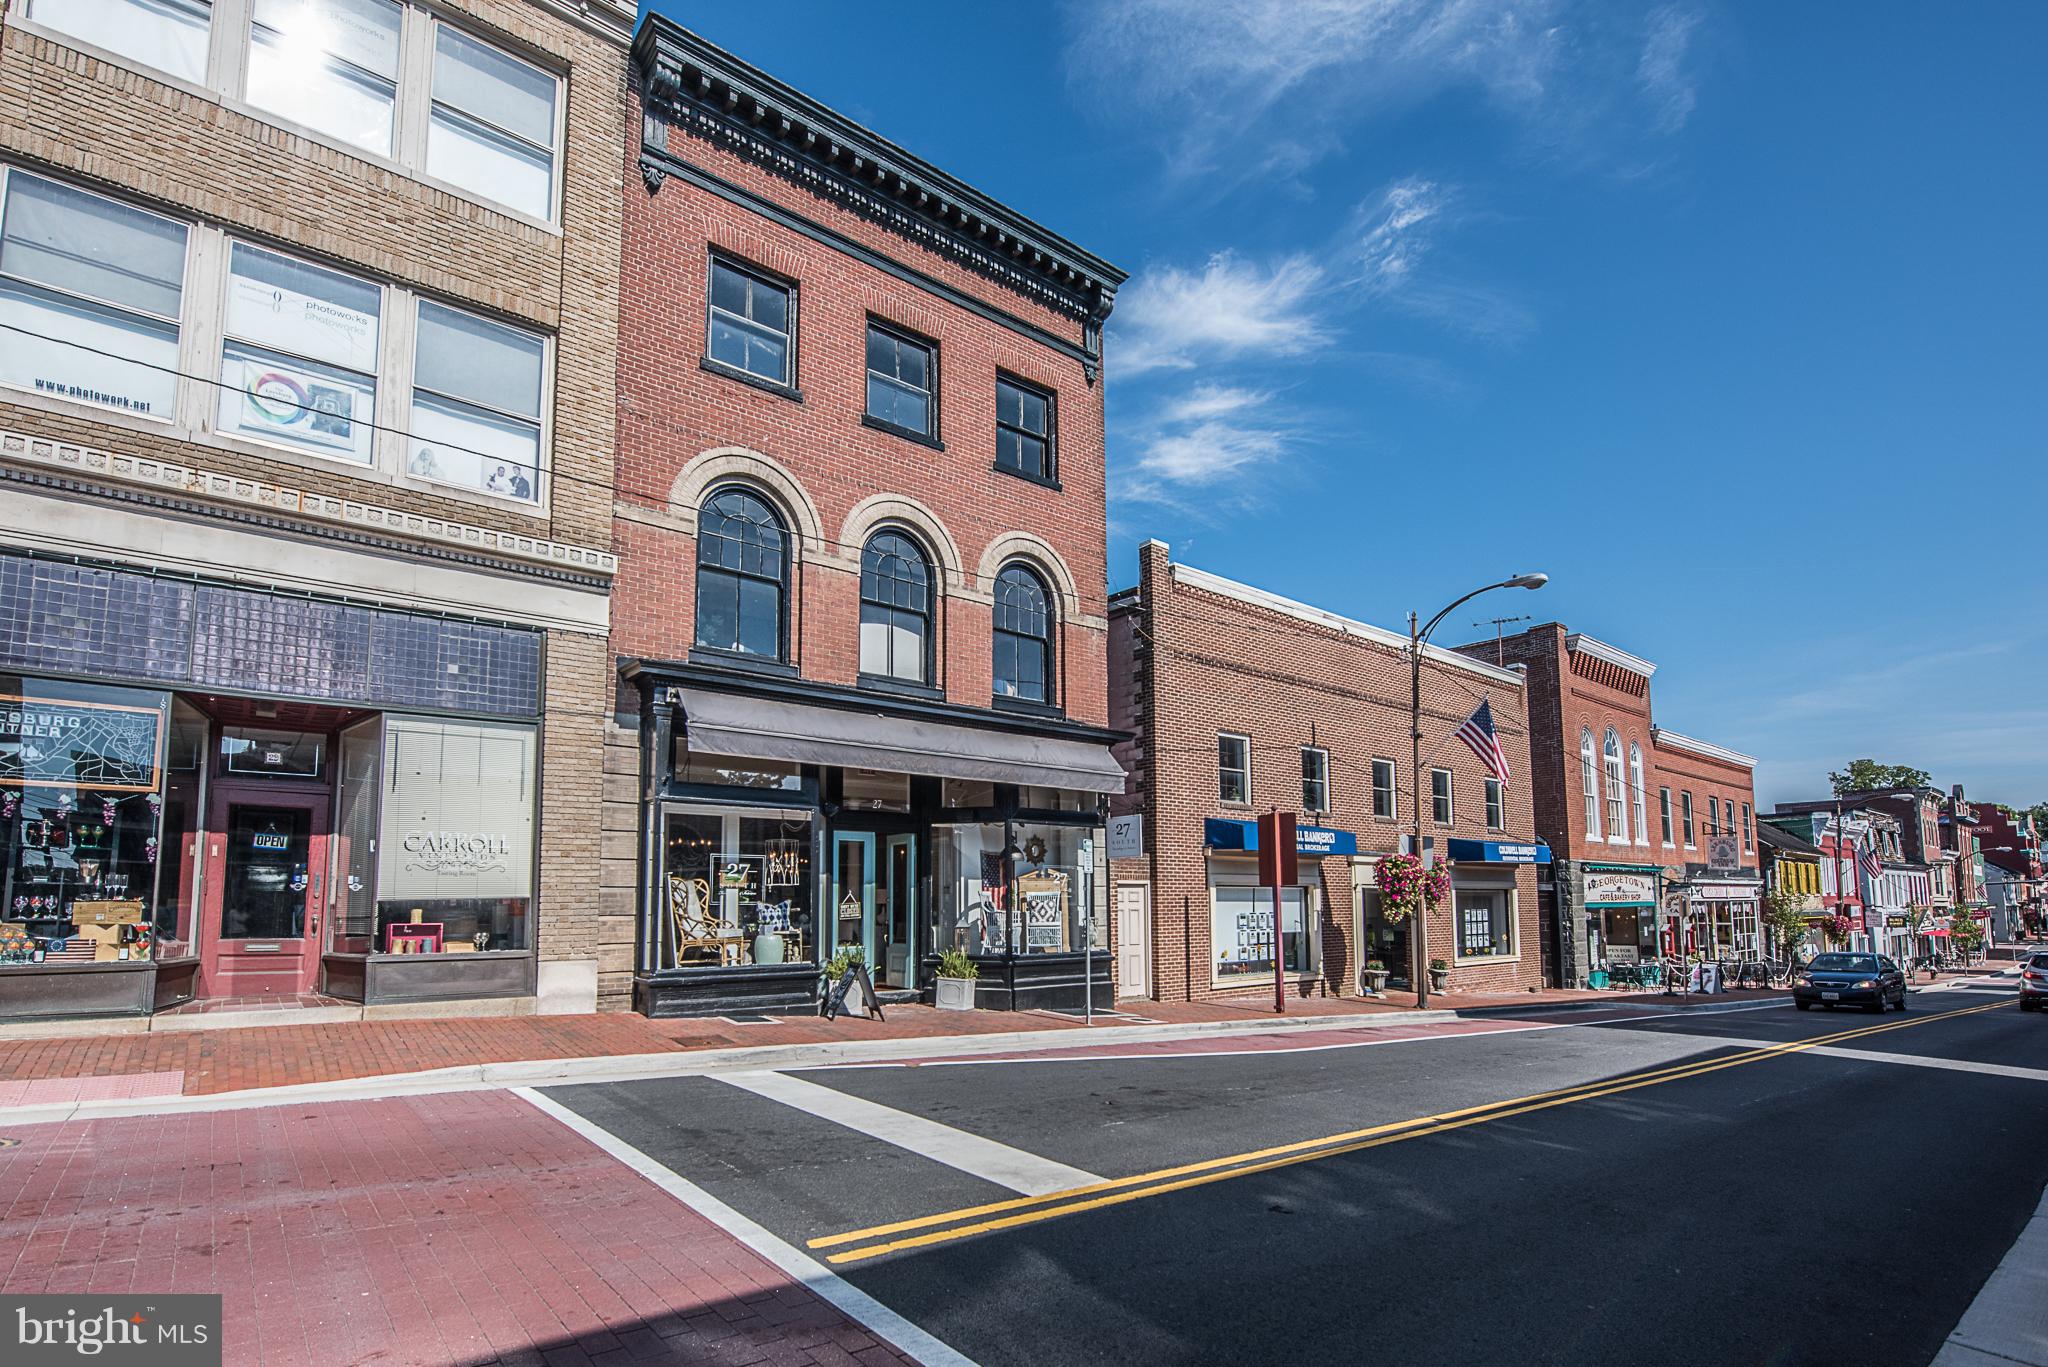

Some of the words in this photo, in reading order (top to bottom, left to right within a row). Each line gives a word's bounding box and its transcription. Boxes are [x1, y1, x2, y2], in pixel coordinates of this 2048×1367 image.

[305, 300, 369, 326] photoworks
[872, 799, 883, 809] 27
[1116, 823, 1131, 838] 27
[256, 834, 285, 848] OPEN
[404, 832, 510, 855] CARROLL
[727, 863, 751, 881] 27
[1593, 875, 1645, 890] GEORGETOWN
[1599, 893, 1611, 901] CAFE
[1614, 893, 1630, 901] BAKERY
[1630, 893, 1641, 901] SHOP
